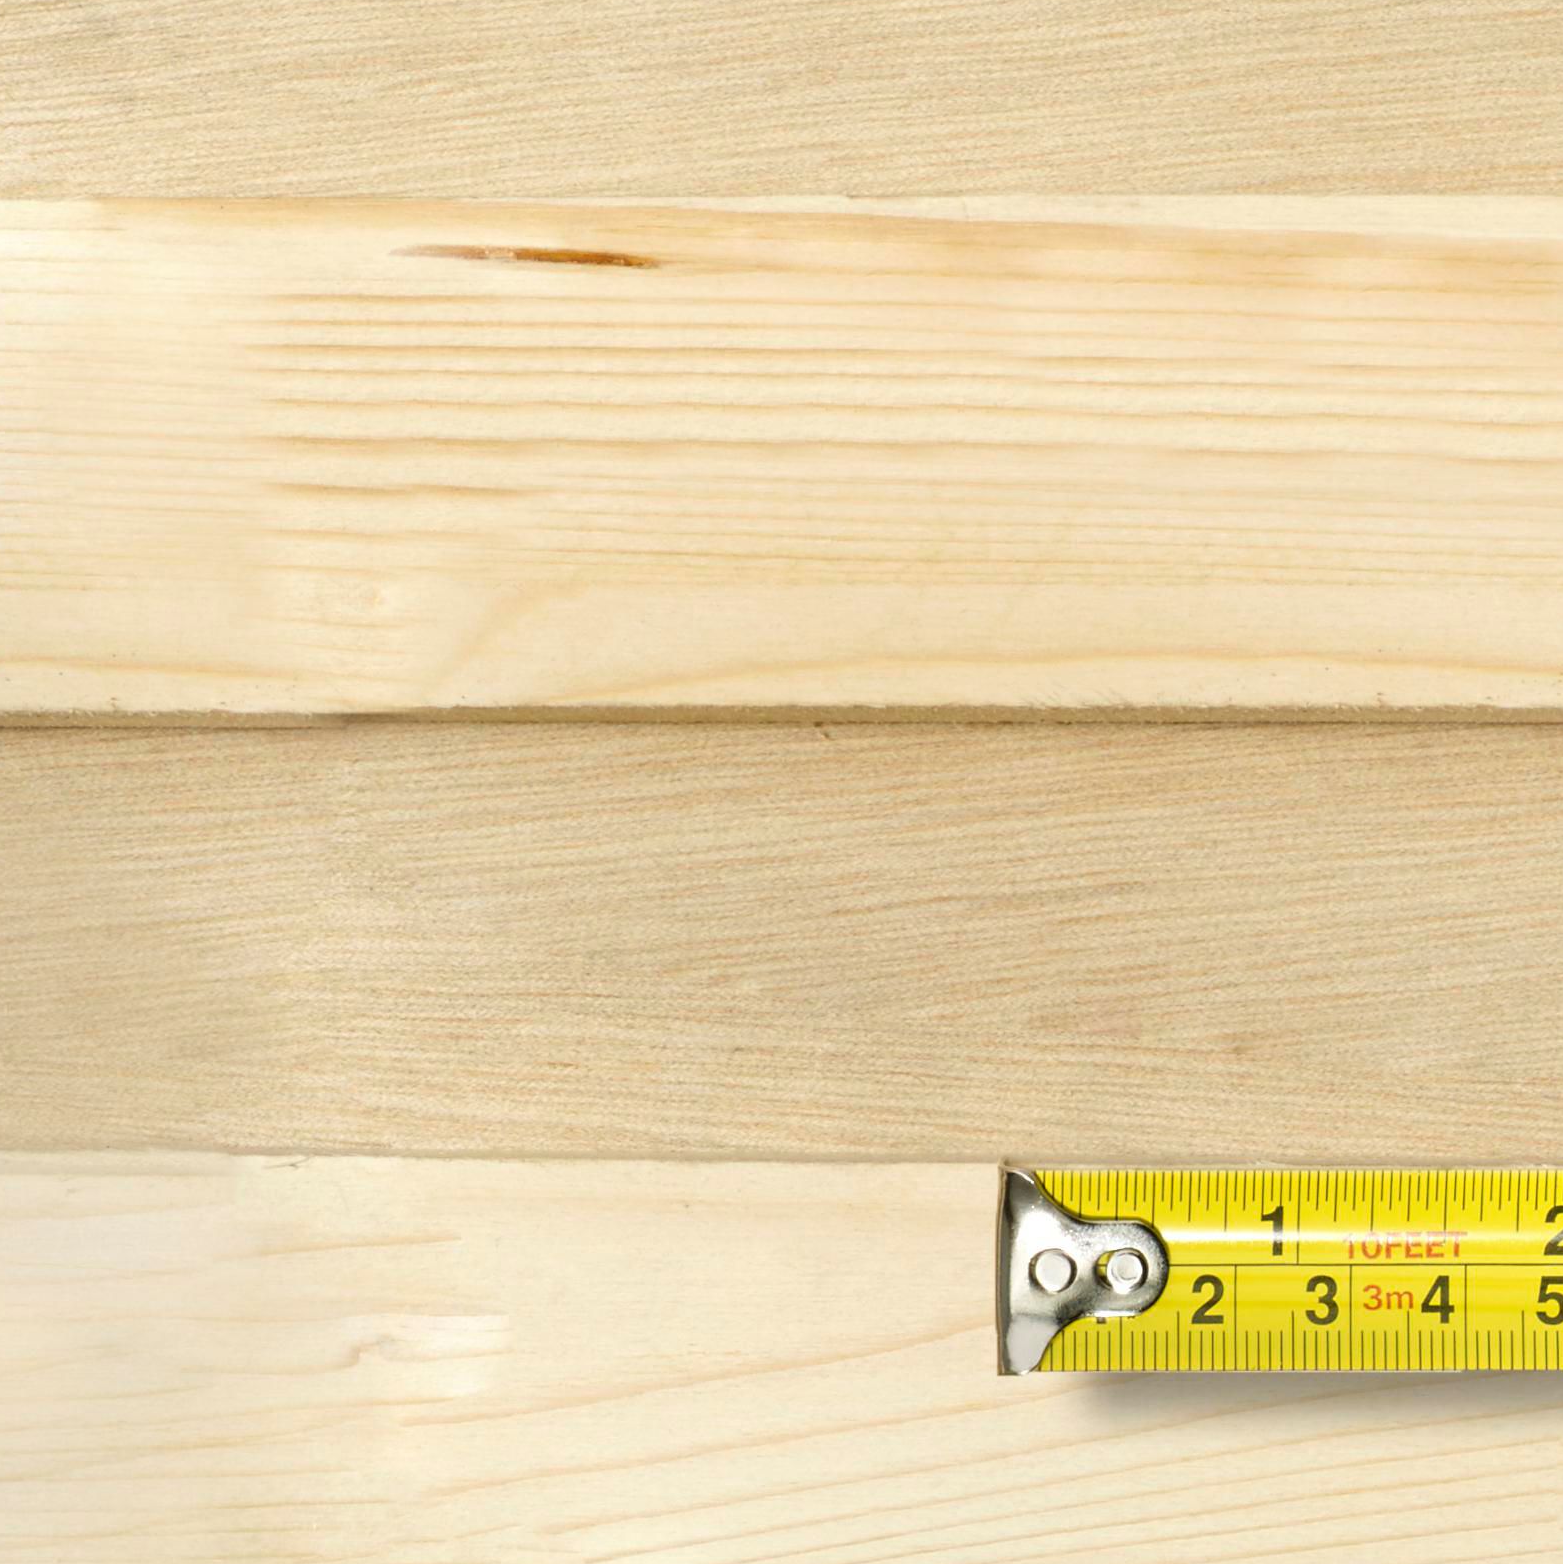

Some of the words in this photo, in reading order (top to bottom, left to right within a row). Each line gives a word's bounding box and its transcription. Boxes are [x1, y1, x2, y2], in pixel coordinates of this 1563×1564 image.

[1260, 1206, 1285, 1256] 1
[1191, 1274, 1224, 1325] 2
[1305, 1275, 1339, 1326] 3
[1362, 1283, 1416, 1312] 3m
[1420, 1275, 1455, 1325] 4
